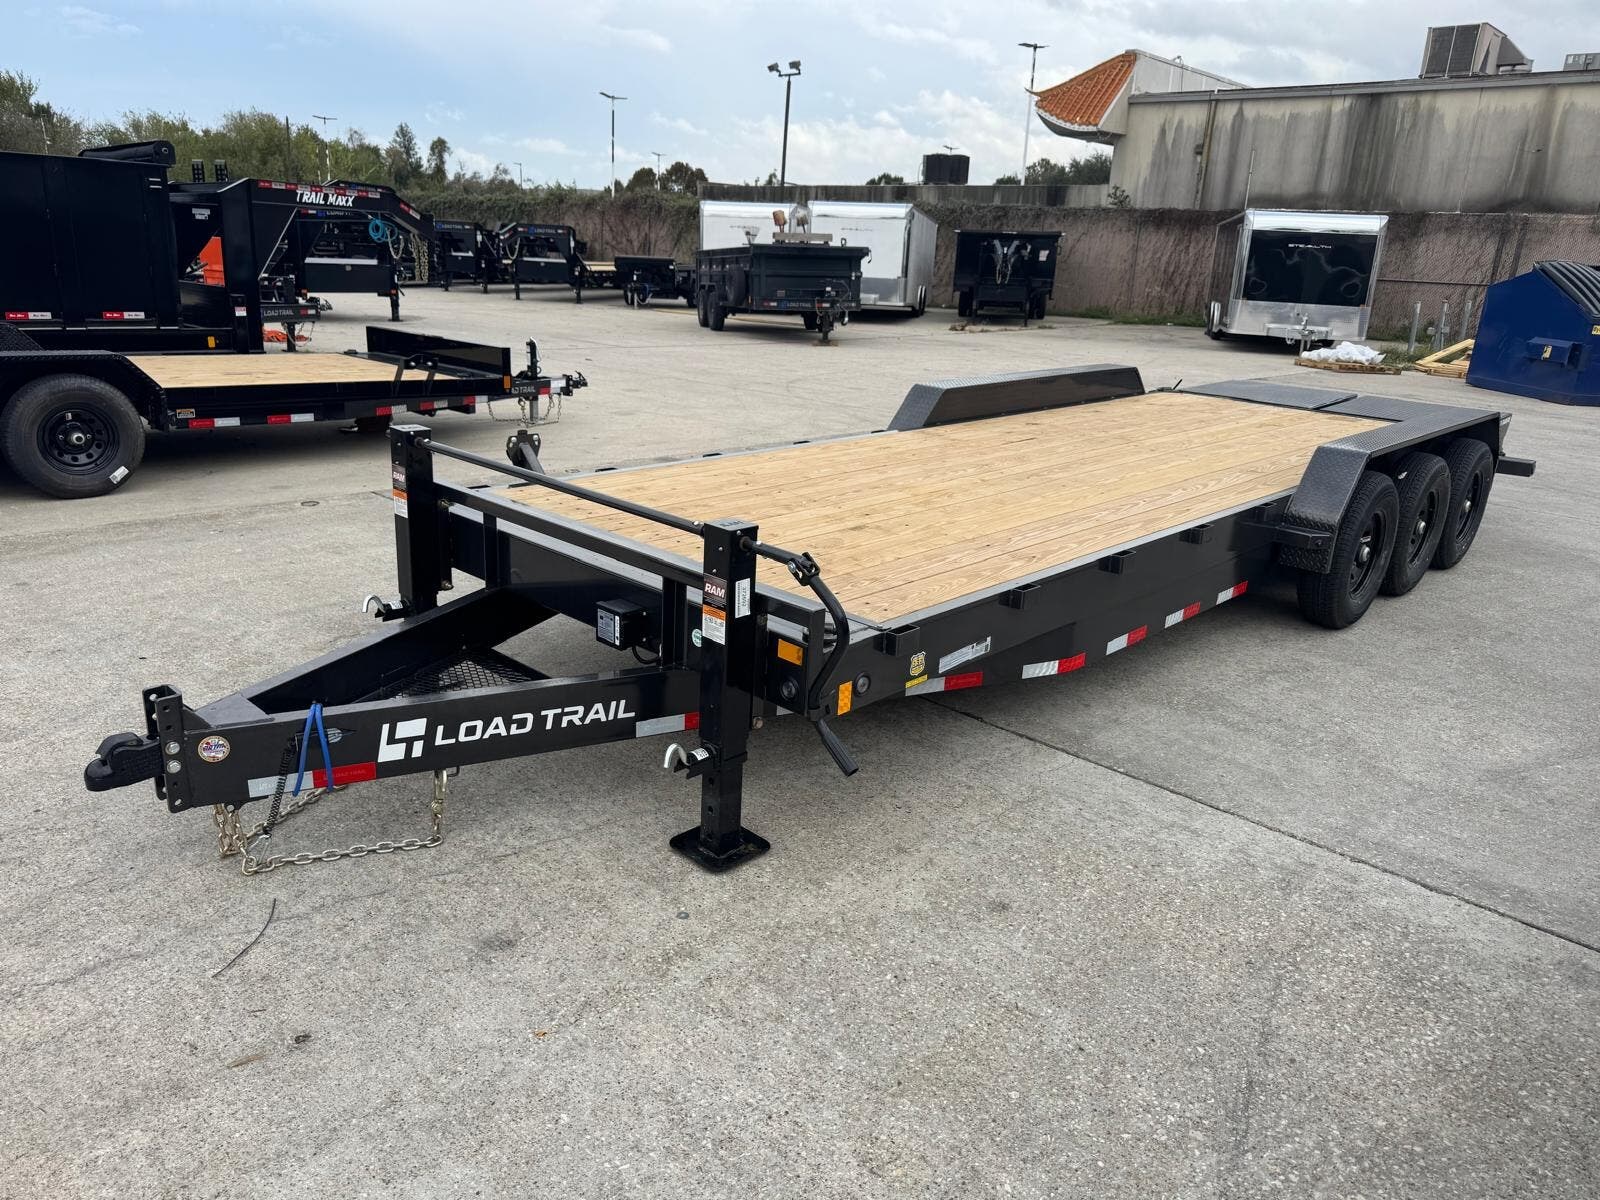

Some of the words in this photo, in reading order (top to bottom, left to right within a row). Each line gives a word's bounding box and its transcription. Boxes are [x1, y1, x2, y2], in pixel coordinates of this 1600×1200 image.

[296, 190, 325, 205] TRAIL
[327, 194, 355, 207] MAXX
[704, 583, 725, 598] RAM
[435, 713, 534, 746] LOAD
[541, 699, 636, 730] TRAIL
